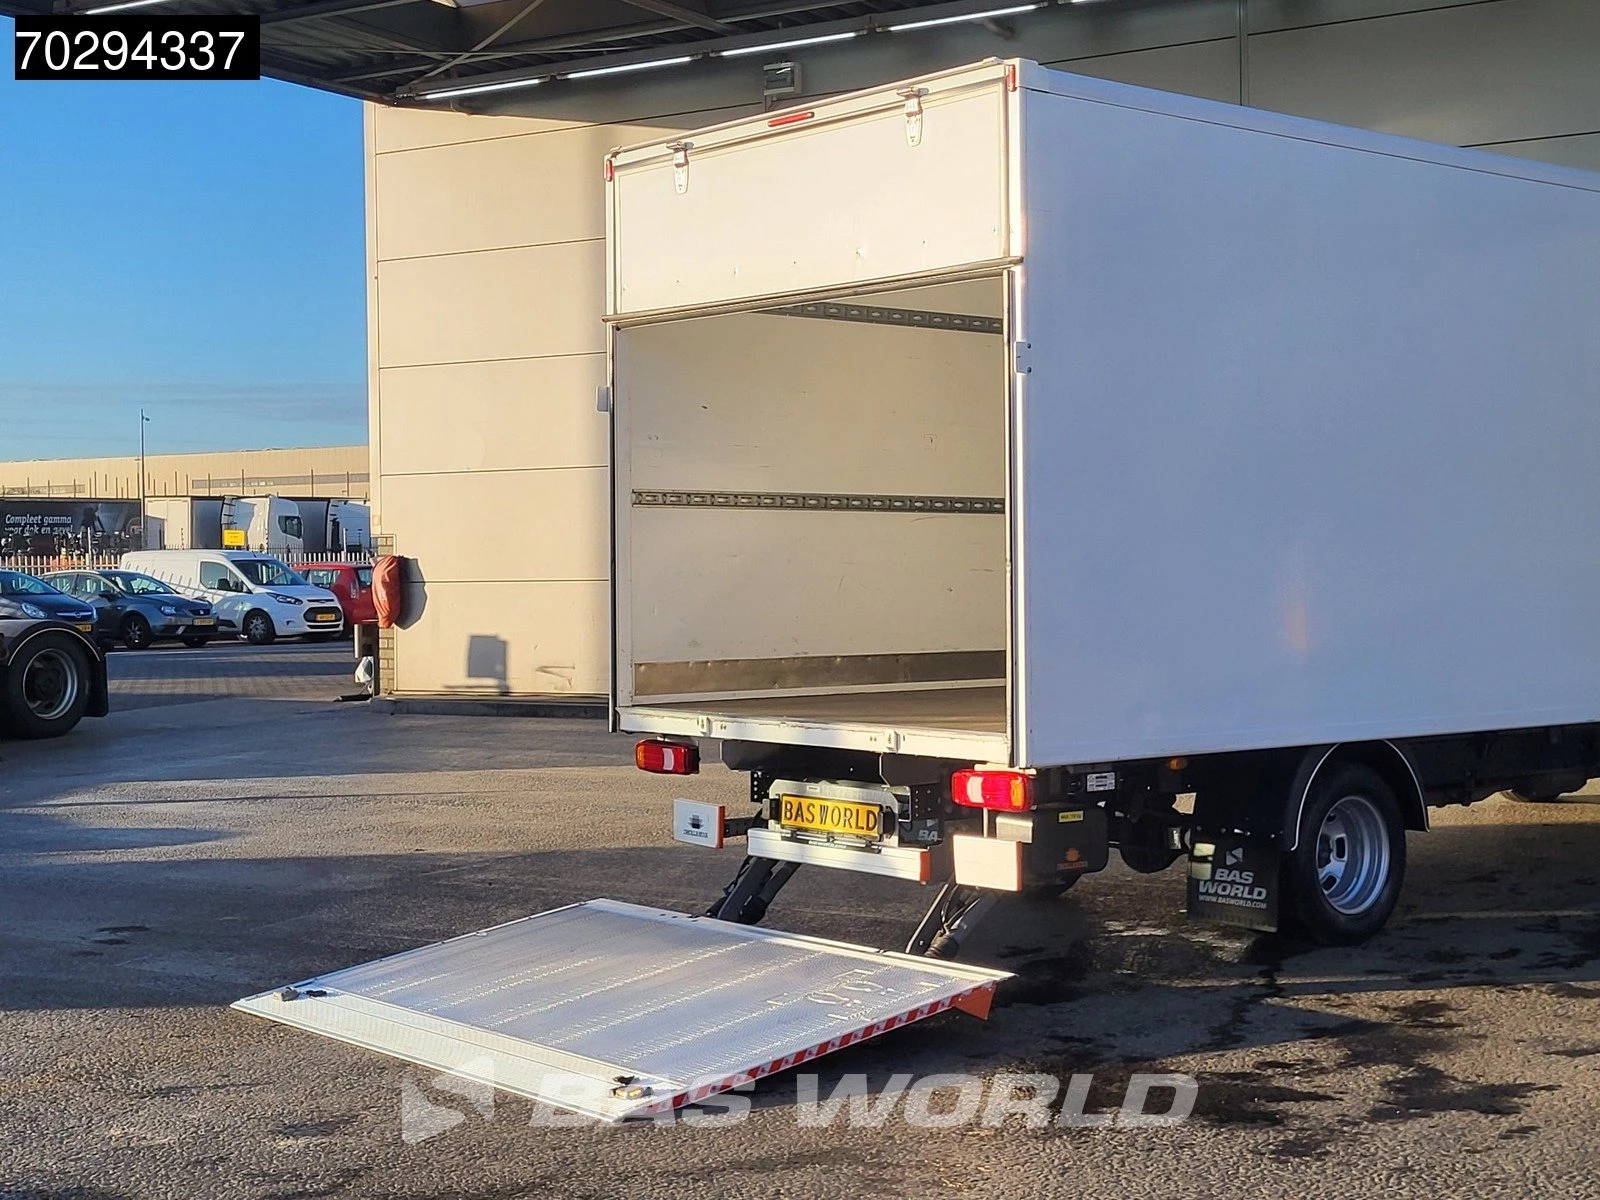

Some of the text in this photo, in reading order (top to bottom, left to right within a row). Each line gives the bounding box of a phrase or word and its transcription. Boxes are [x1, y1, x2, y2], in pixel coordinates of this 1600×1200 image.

[5, 514, 72, 526] Compleet gamma
[41, 526, 51, 534] en
[784, 800, 878, 832] BAS WORLD
[918, 829, 942, 842] BA
[1215, 868, 1254, 884] BAS
[1199, 881, 1267, 900] WORLD
[1198, 894, 1267, 910] WWW.BASWORLD.COM
